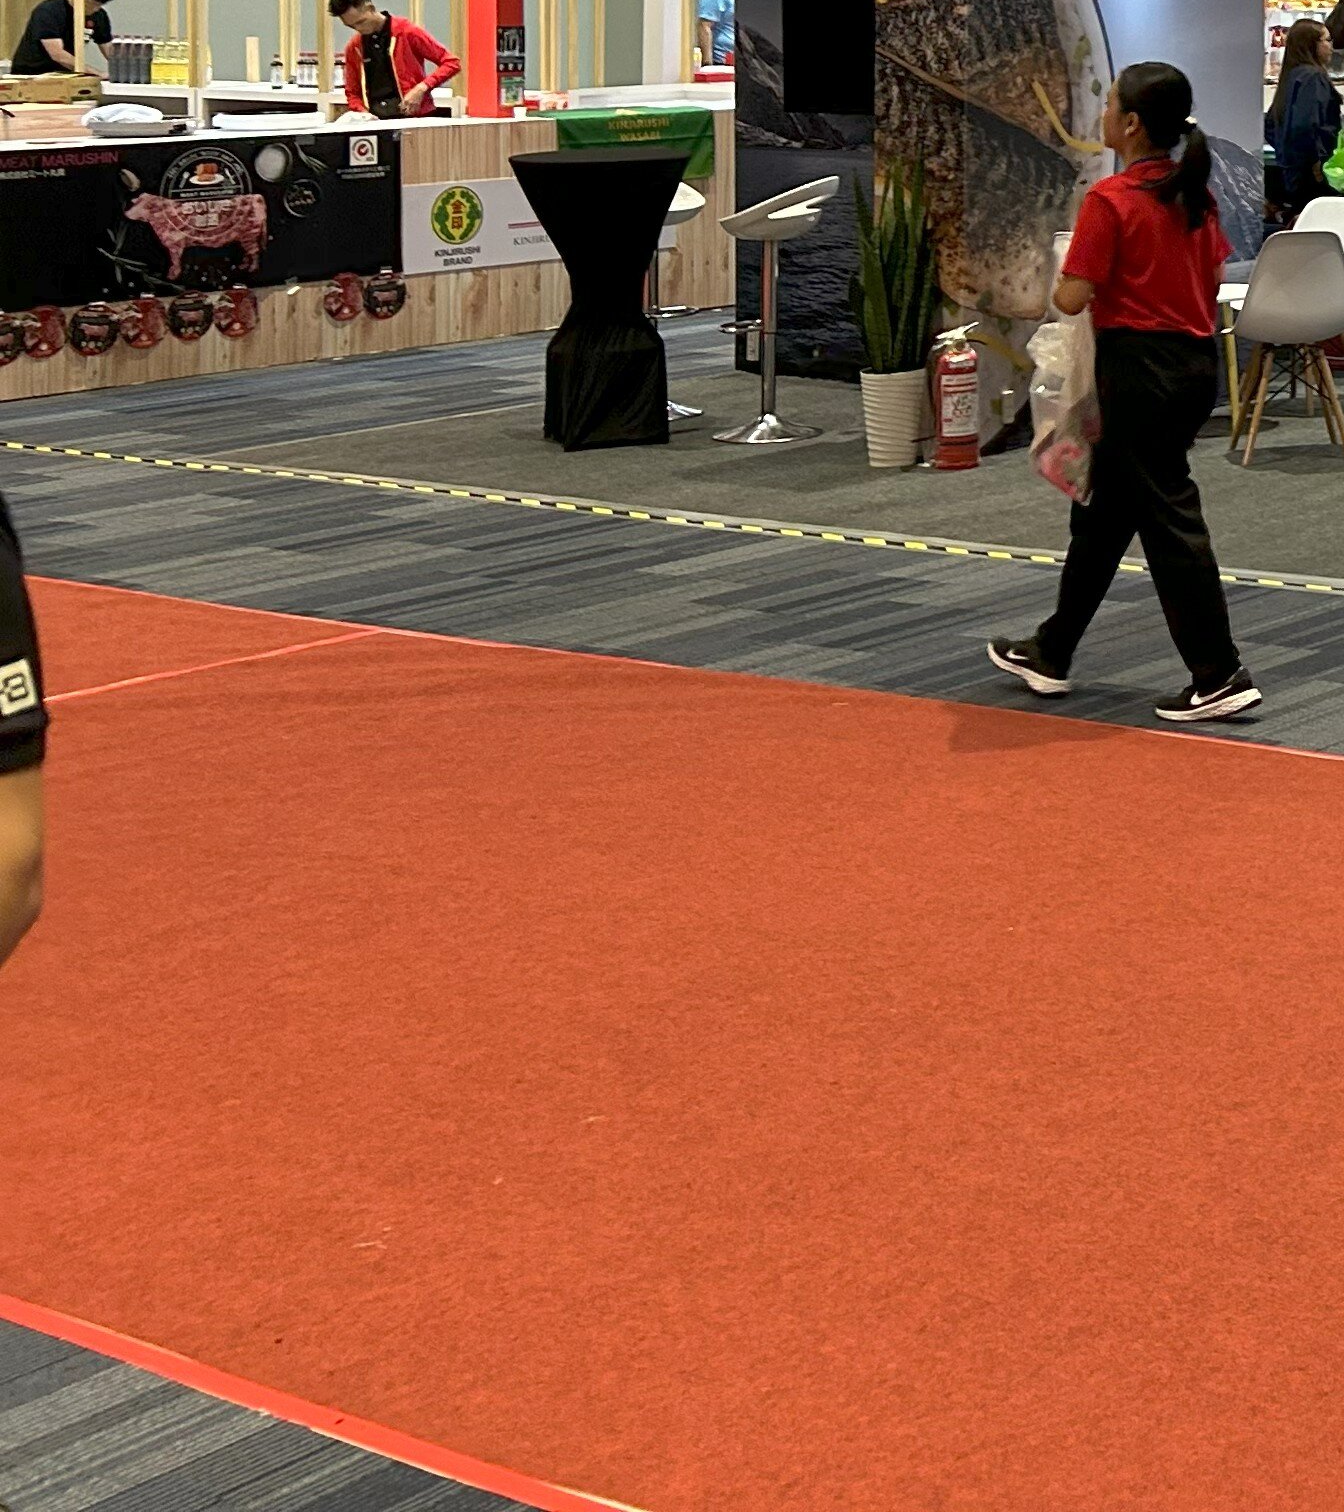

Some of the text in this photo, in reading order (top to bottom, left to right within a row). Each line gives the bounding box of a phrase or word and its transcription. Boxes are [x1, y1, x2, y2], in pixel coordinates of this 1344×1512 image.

[0, 151, 119, 169] MEAT MARUSHIN
[434, 245, 481, 257] KINJIRUSHI
[443, 255, 473, 266] BRAND
